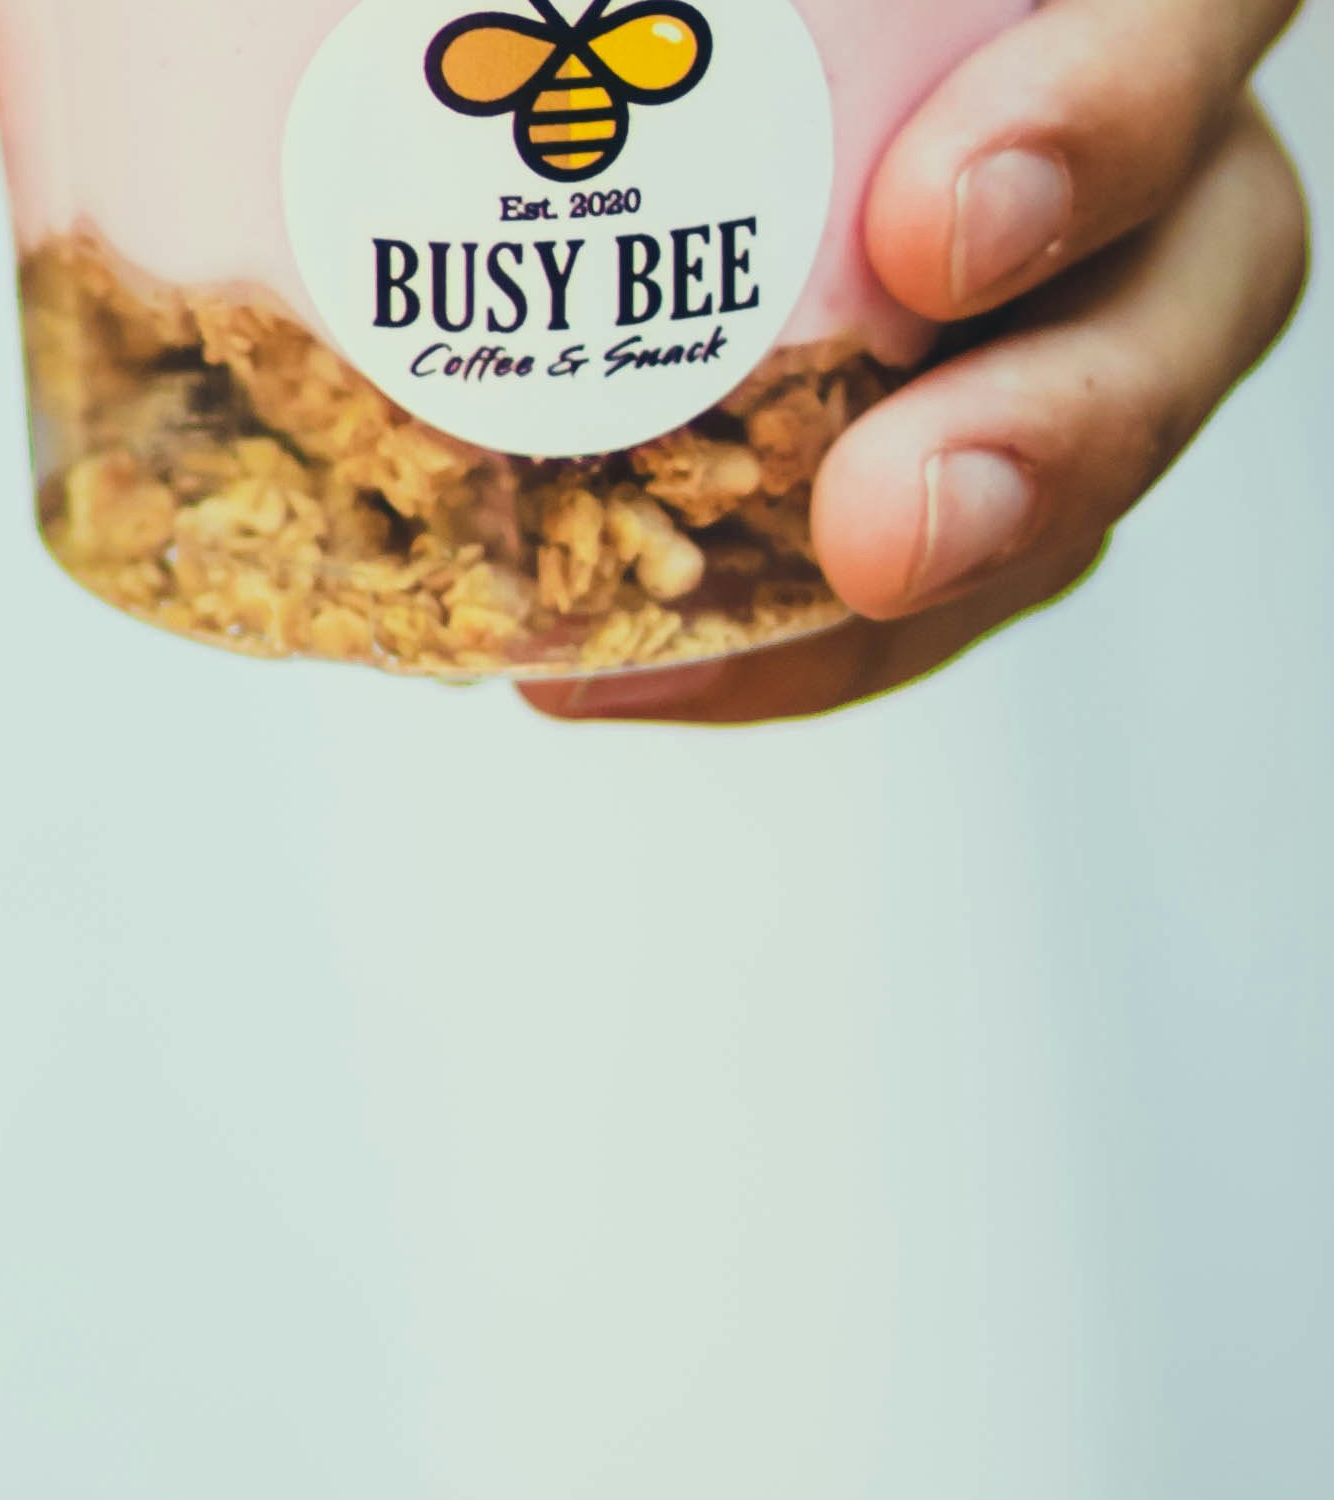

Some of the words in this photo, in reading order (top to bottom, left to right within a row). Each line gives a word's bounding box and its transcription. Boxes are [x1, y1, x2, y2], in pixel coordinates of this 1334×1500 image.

[499, 195, 558, 221] Est.
[569, 187, 642, 219] 2020
[372, 238, 585, 333] BUSY
[615, 216, 760, 327] BEE
[410, 342, 536, 382] Coffee
[547, 344, 590, 377] &
[604, 325, 728, 377] Snack
